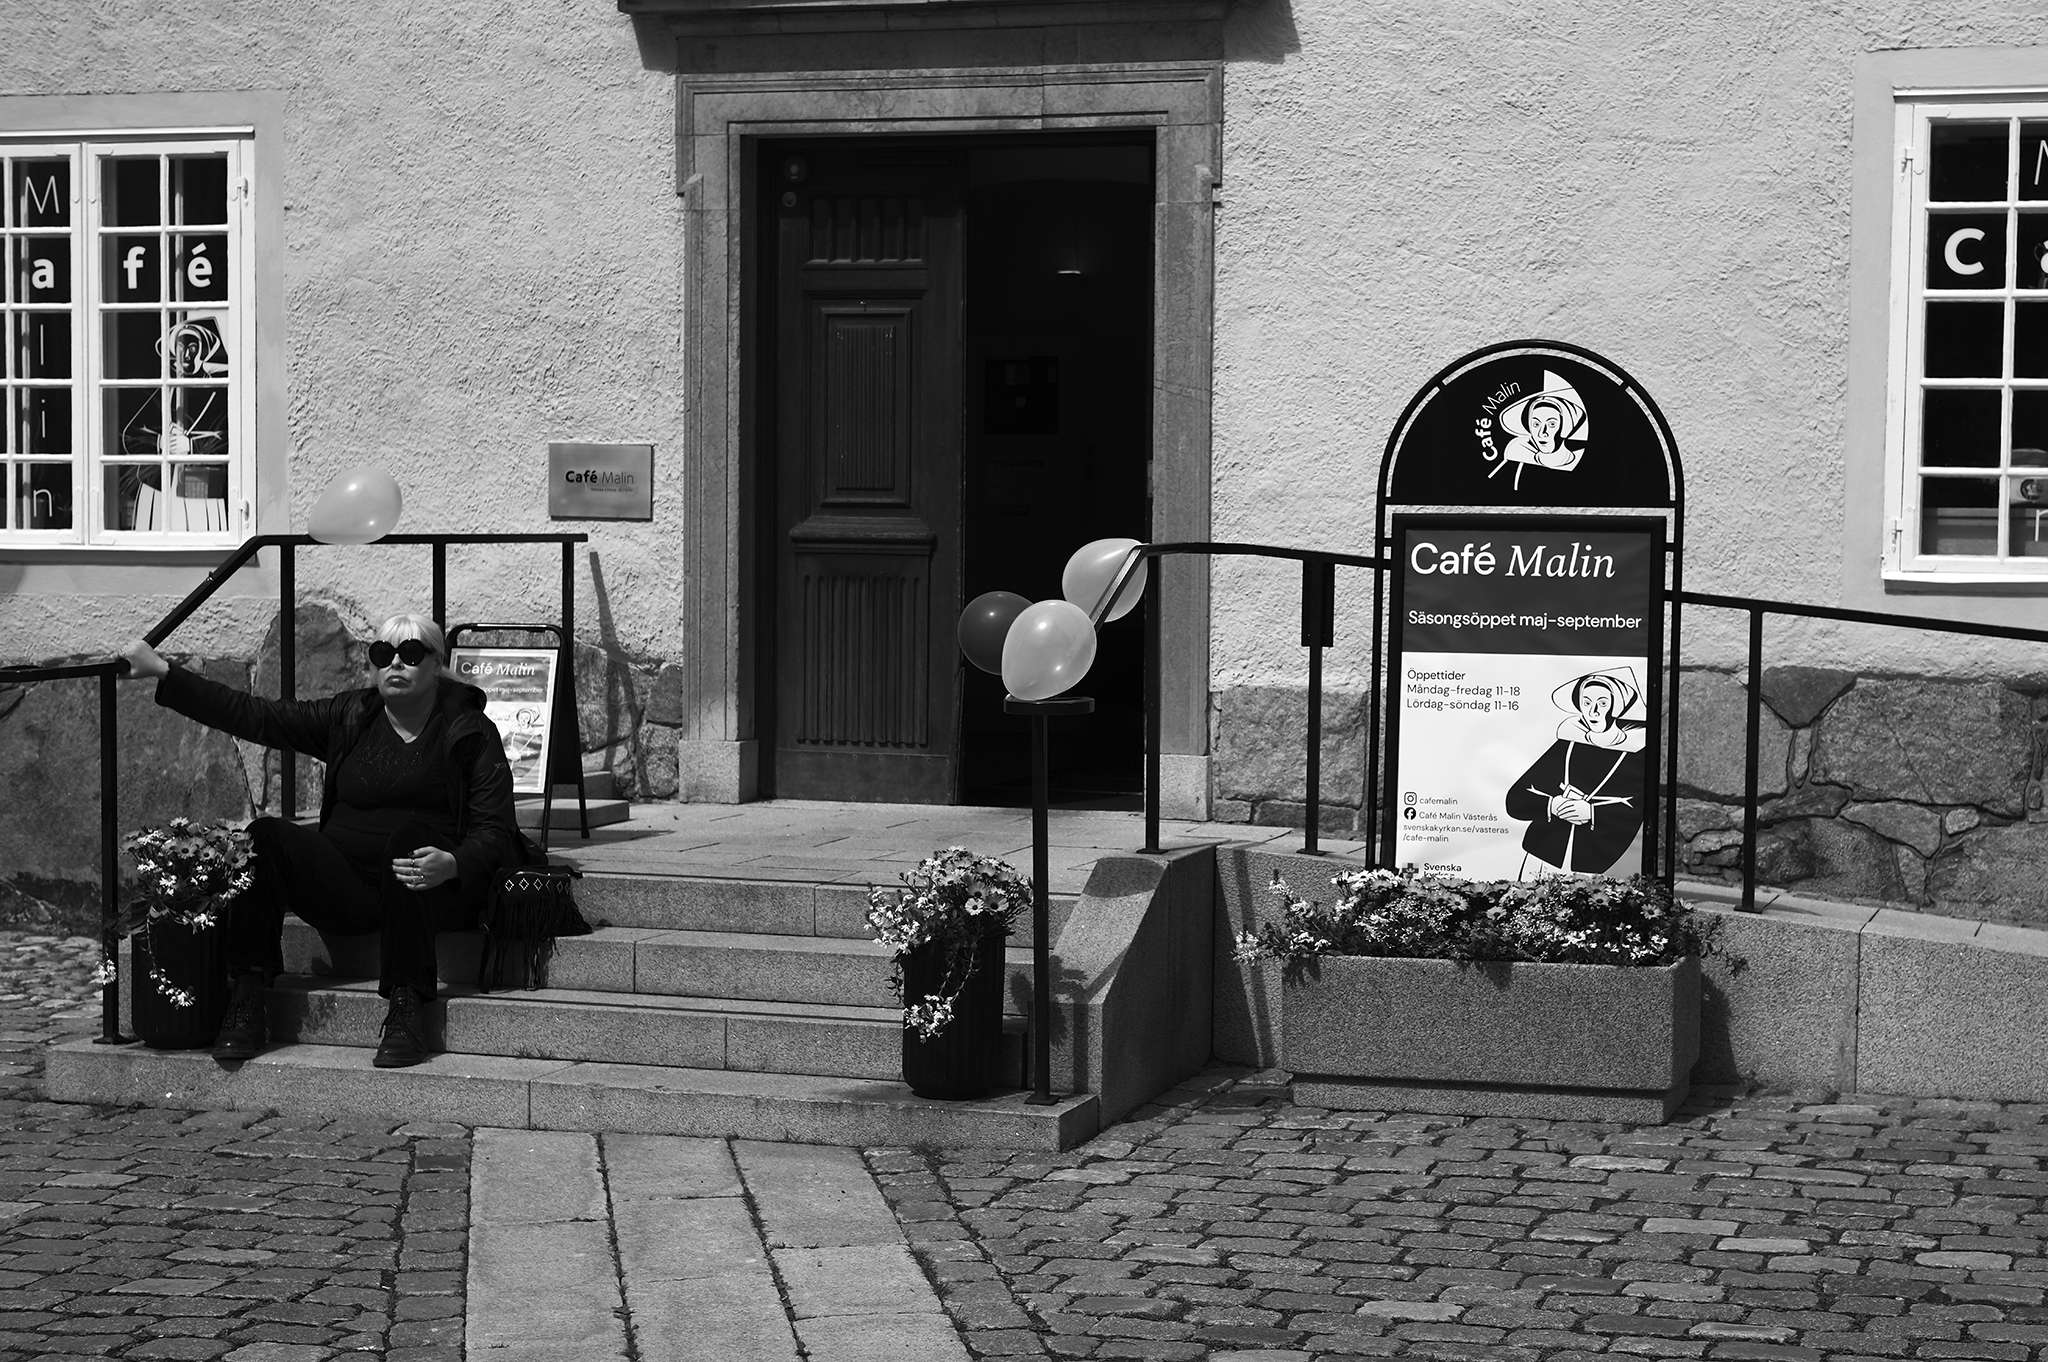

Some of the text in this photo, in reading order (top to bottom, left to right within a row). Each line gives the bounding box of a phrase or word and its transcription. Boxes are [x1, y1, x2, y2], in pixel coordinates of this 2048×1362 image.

[1474, 382, 1521, 461] Café Malin
[565, 470, 634, 485] Café Malin
[1410, 542, 1616, 579] Café Malin
[1408, 610, 1517, 629] Säsongsöppet
[461, 661, 535, 676] Café Malin
[1407, 667, 1466, 681] Öppettider
[1419, 797, 1458, 805] cafemalin
[1419, 811, 1498, 821] Café Malin Västerås
[1423, 862, 1462, 872] Svenska
